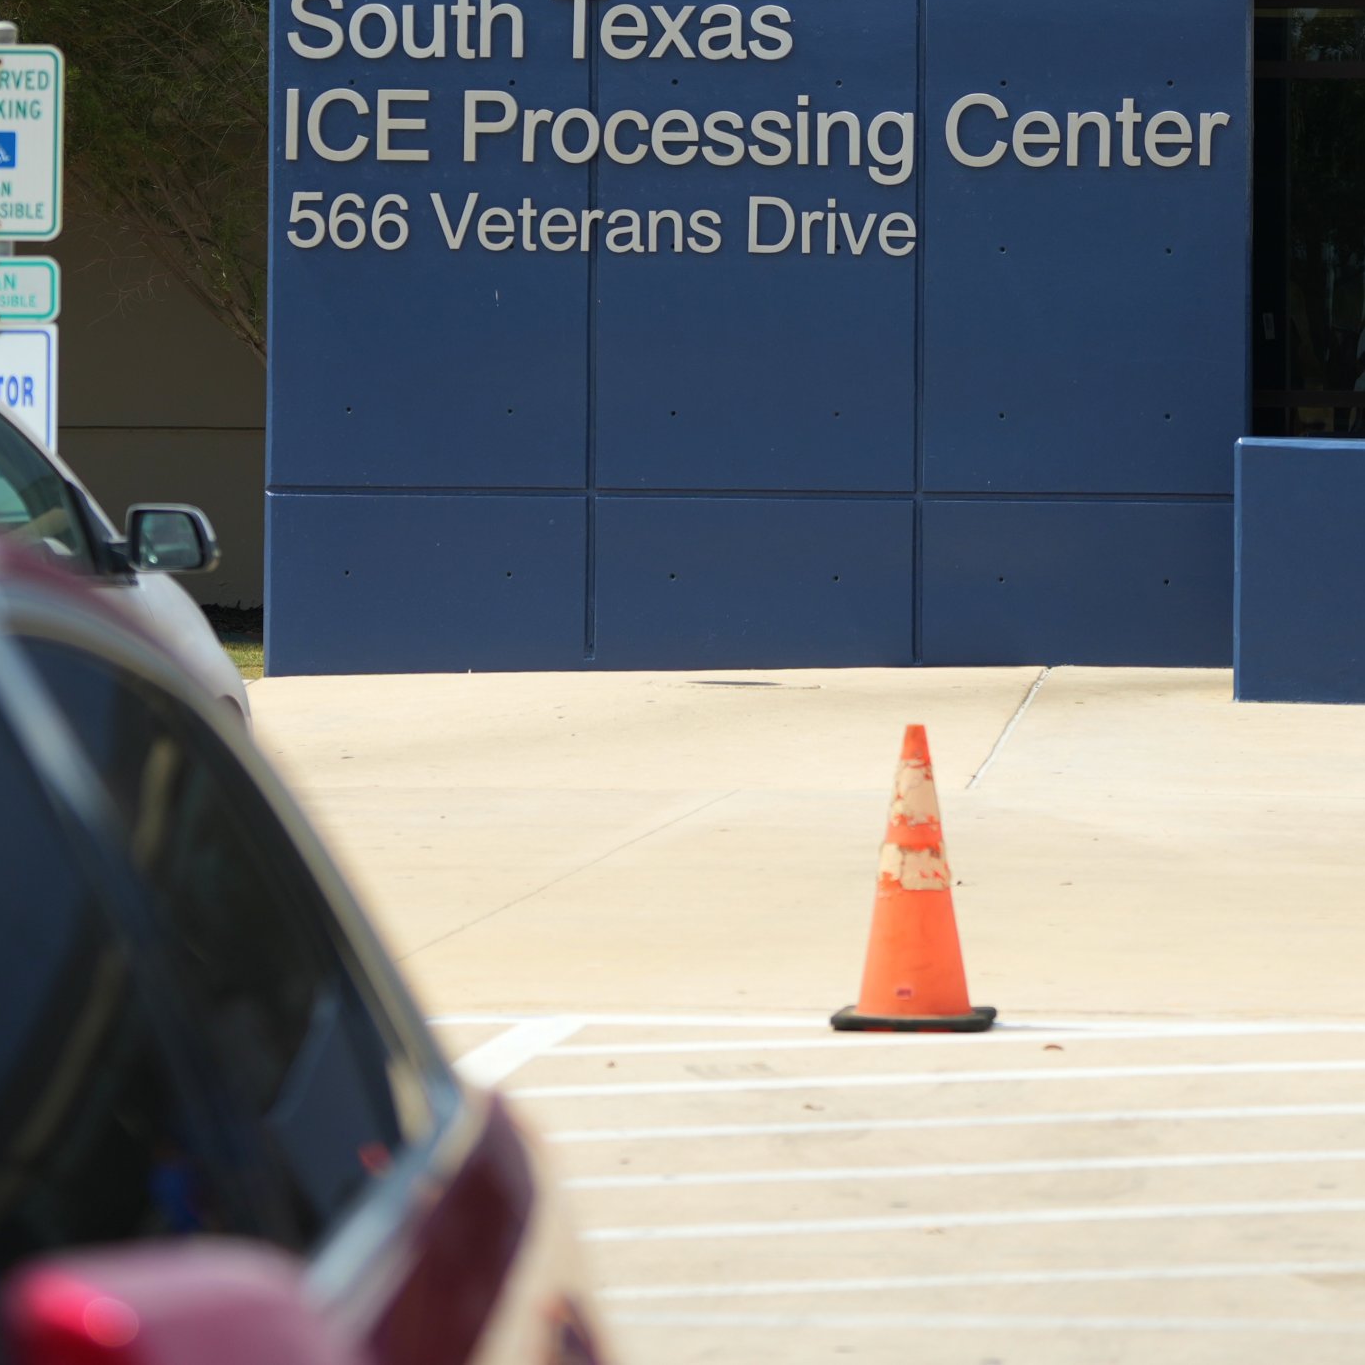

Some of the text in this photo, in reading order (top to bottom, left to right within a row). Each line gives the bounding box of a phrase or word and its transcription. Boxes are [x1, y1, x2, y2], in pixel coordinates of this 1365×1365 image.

[285, 88, 1231, 186] ICE Processing Center
[286, 191, 918, 257] 566 Veterans Drive
